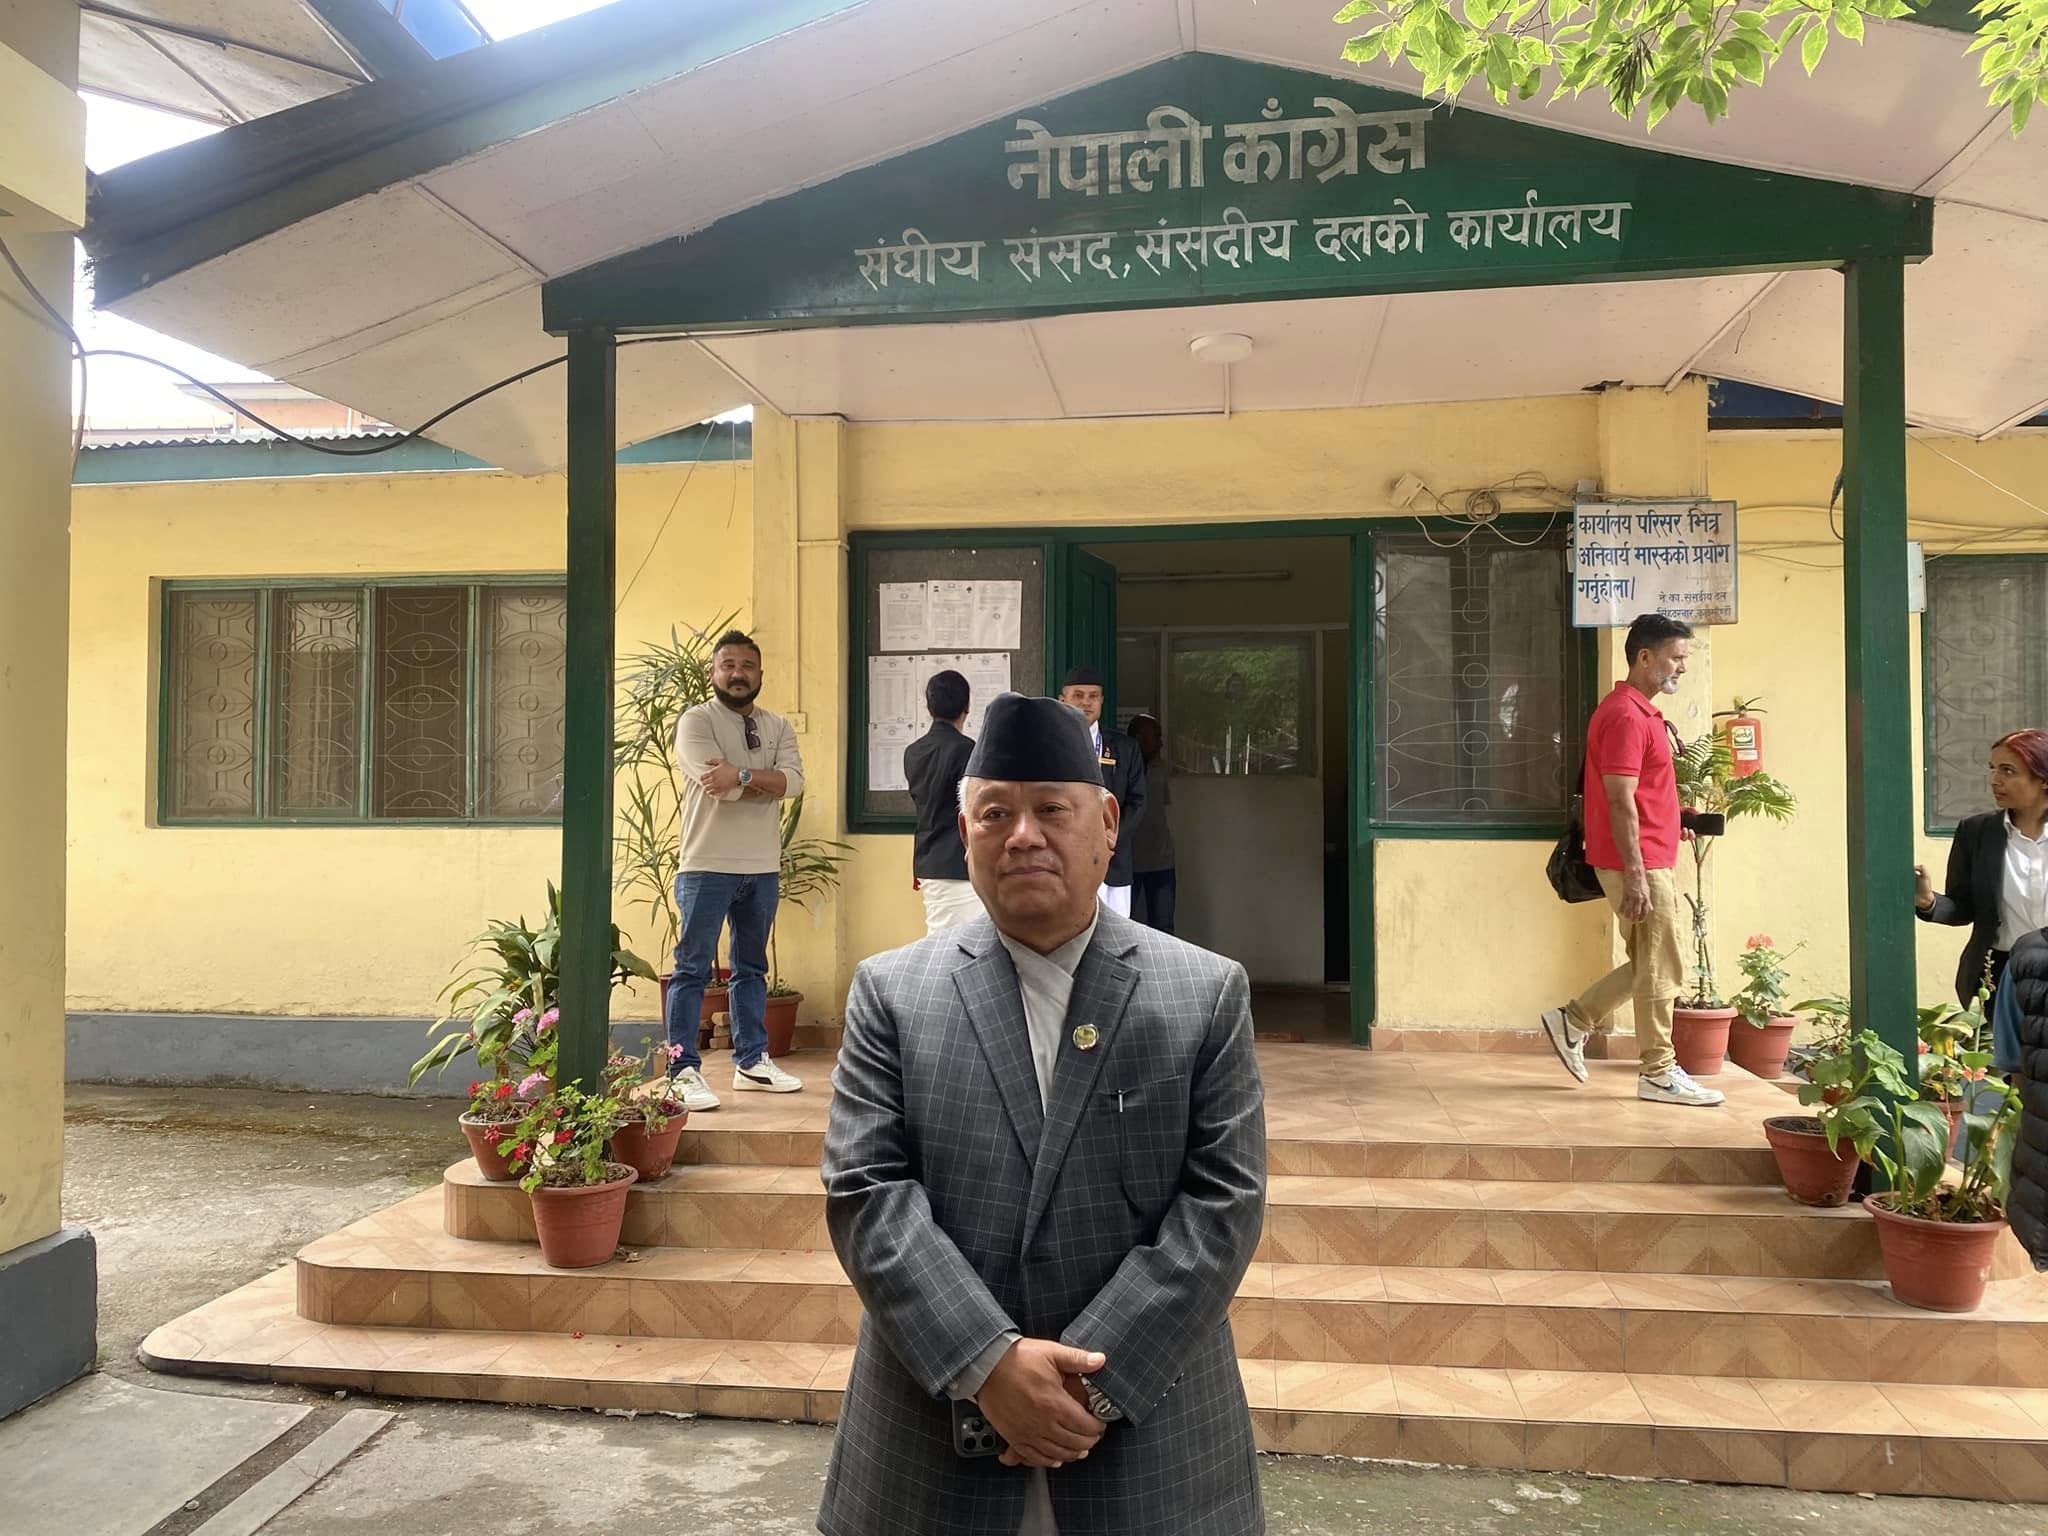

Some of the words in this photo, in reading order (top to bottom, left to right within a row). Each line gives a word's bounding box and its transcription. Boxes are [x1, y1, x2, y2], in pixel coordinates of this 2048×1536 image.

[1004, 105, 1214, 199] नेपाली
[1223, 96, 1434, 185] काँग्रेस
[854, 227, 986, 292] संघीय
[1002, 226, 1131, 284] संसद,
[1134, 206, 1299, 277] संसदीय
[1312, 198, 1430, 262] दलको
[1447, 189, 1632, 249] कार्यालय
[1578, 508, 1633, 539] कार्यालय
[1636, 508, 1683, 538] परिसर
[1687, 506, 1722, 535] भित्र
[1578, 541, 1631, 567] अनिवार्य
[1634, 540, 1690, 570] मास्कको
[1692, 539, 1731, 565] प्रयोग
